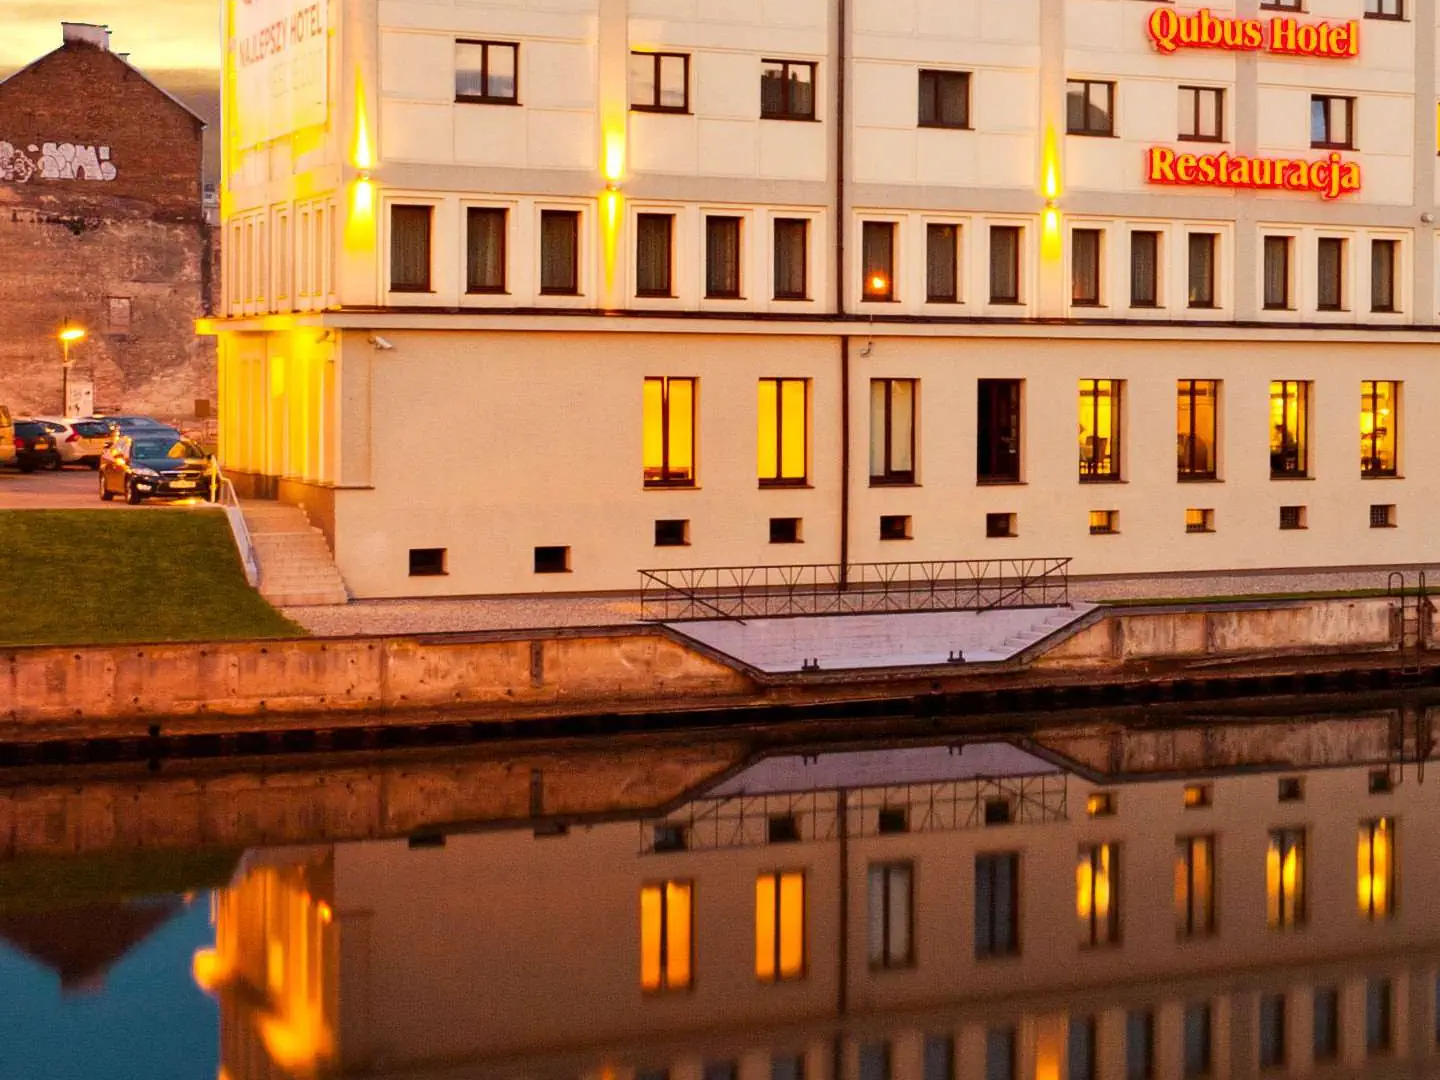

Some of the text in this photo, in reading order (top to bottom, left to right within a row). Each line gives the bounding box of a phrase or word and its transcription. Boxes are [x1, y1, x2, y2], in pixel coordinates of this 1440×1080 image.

[290, 2, 322, 43] HOTEL
[1148, 7, 1360, 58] Qubus Hotel
[1148, 146, 1361, 199] Restauracja
